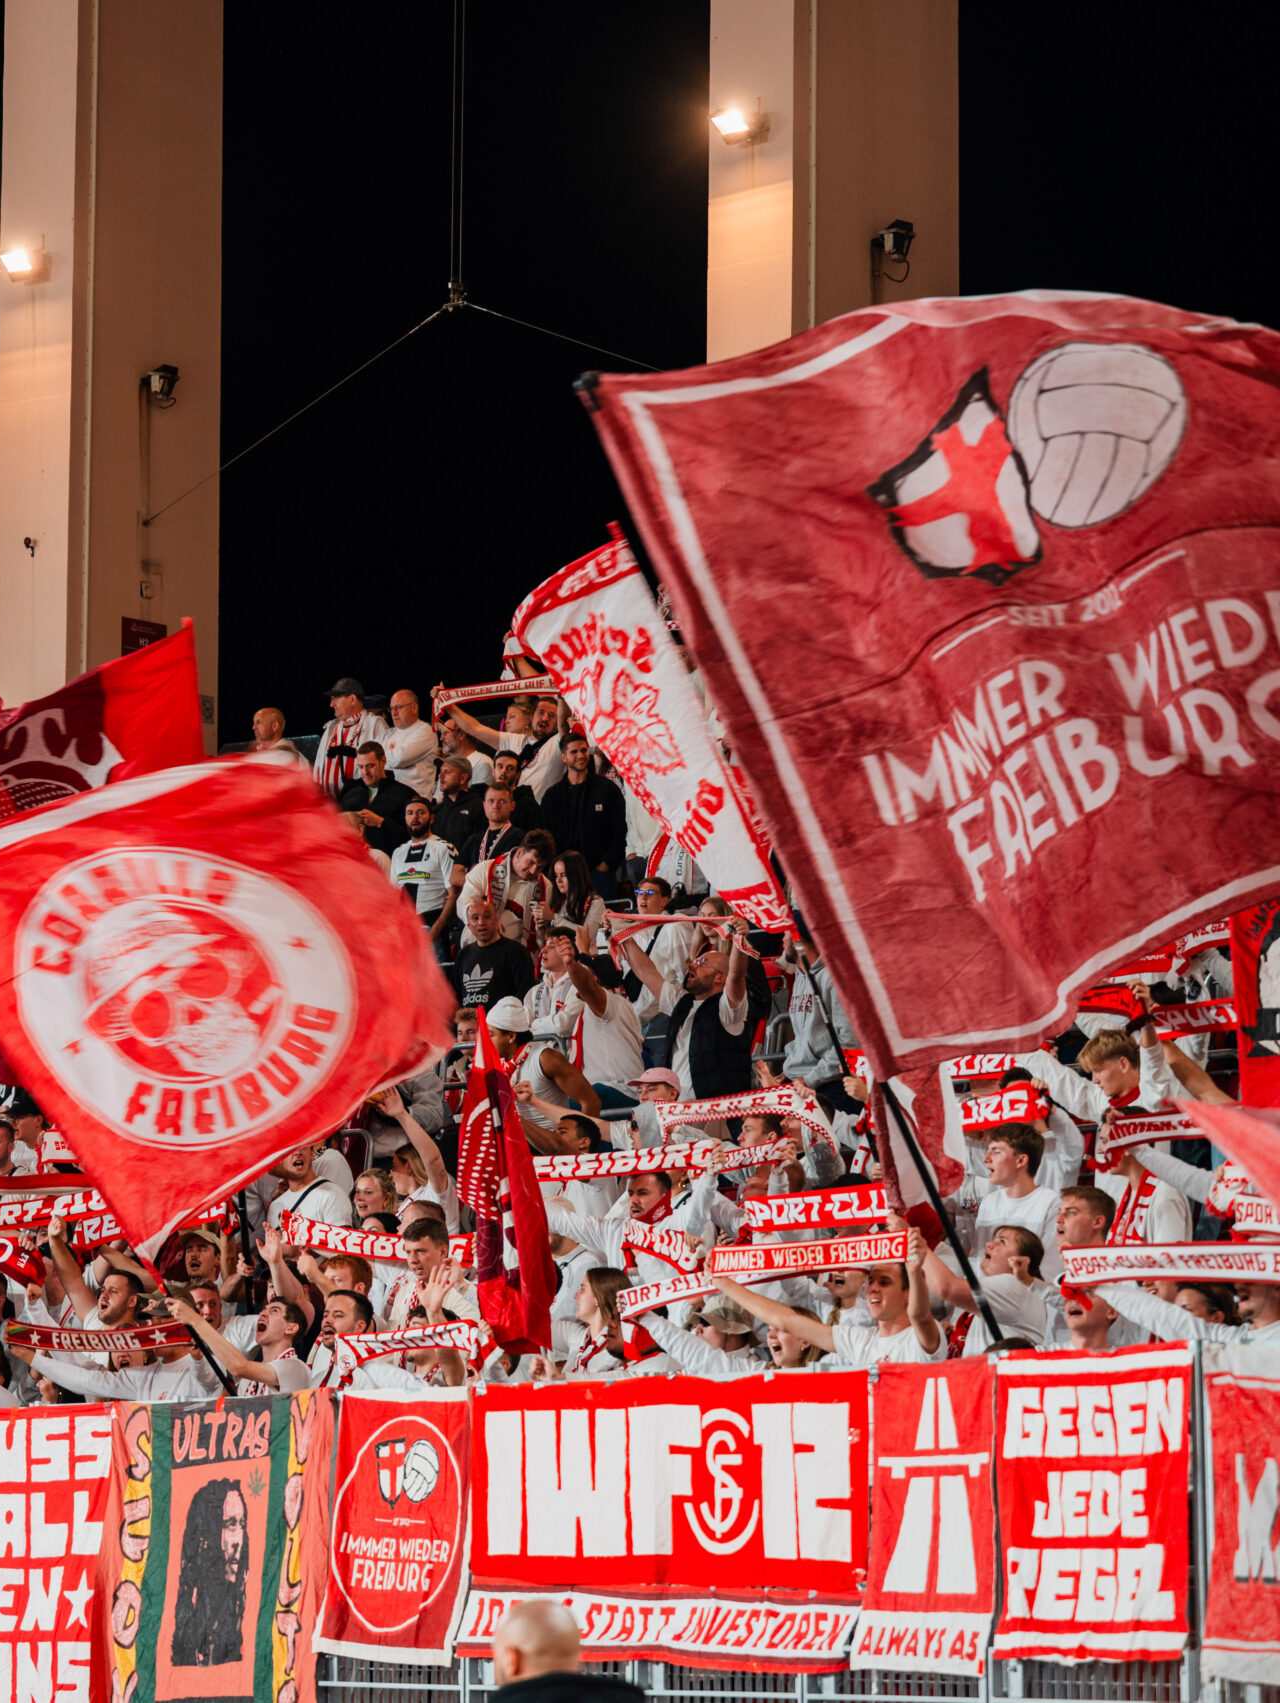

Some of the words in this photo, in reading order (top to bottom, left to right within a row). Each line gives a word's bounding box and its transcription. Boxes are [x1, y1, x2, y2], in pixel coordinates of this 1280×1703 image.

[1007, 604, 1069, 628] SEIT
[123, 1002, 339, 1136] FREIBURG
[533, 1139, 716, 1179] FREIBURG
[1235, 1201, 1278, 1226] SPOR
[770, 1245, 825, 1268] WIEDER
[830, 1237, 904, 1265] FREIBURG
[1178, 1252, 1266, 1272] FREIBURG
[52, 1332, 141, 1351] FREIBURG
[1003, 1377, 1184, 1459] GEGEN
[172, 1410, 272, 1464] ULTRAS
[1031, 1467, 1150, 1538] JEDE
[399, 1537, 450, 1563] WIEDER
[350, 1558, 434, 1592] FREIBURG
[1006, 1543, 1176, 1622] REGEL
[580, 1602, 676, 1643] STATT
[672, 1605, 850, 1651] INVESTOREN
[858, 1625, 947, 1660] ALWAYS
